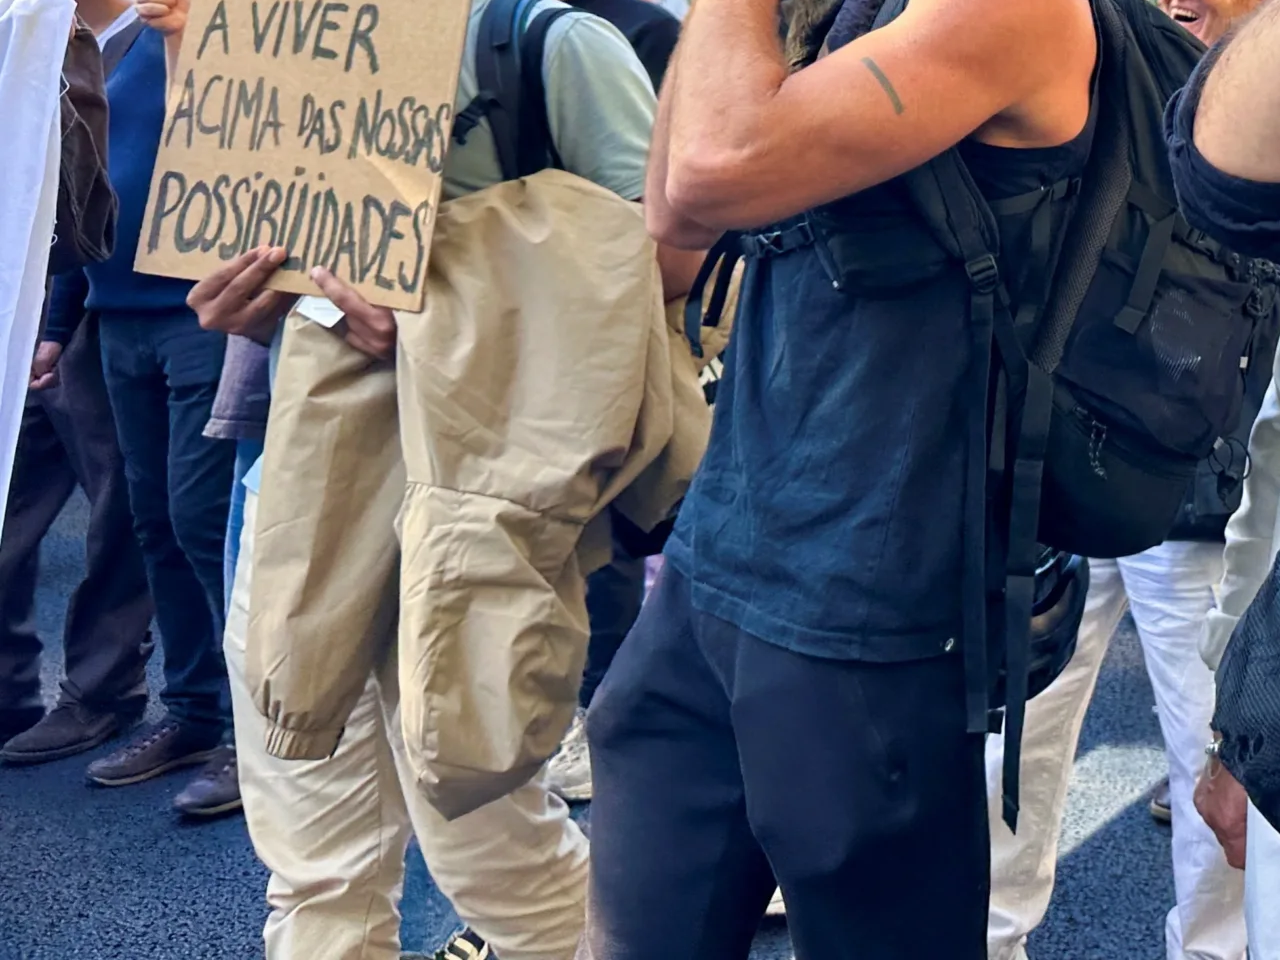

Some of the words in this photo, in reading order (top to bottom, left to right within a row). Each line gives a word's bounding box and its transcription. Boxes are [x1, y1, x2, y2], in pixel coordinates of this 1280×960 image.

[197, 0, 229, 60] A
[165, 68, 286, 150] ACIMA
[297, 93, 346, 156] DAS
[347, 89, 451, 174] NOSSAS
